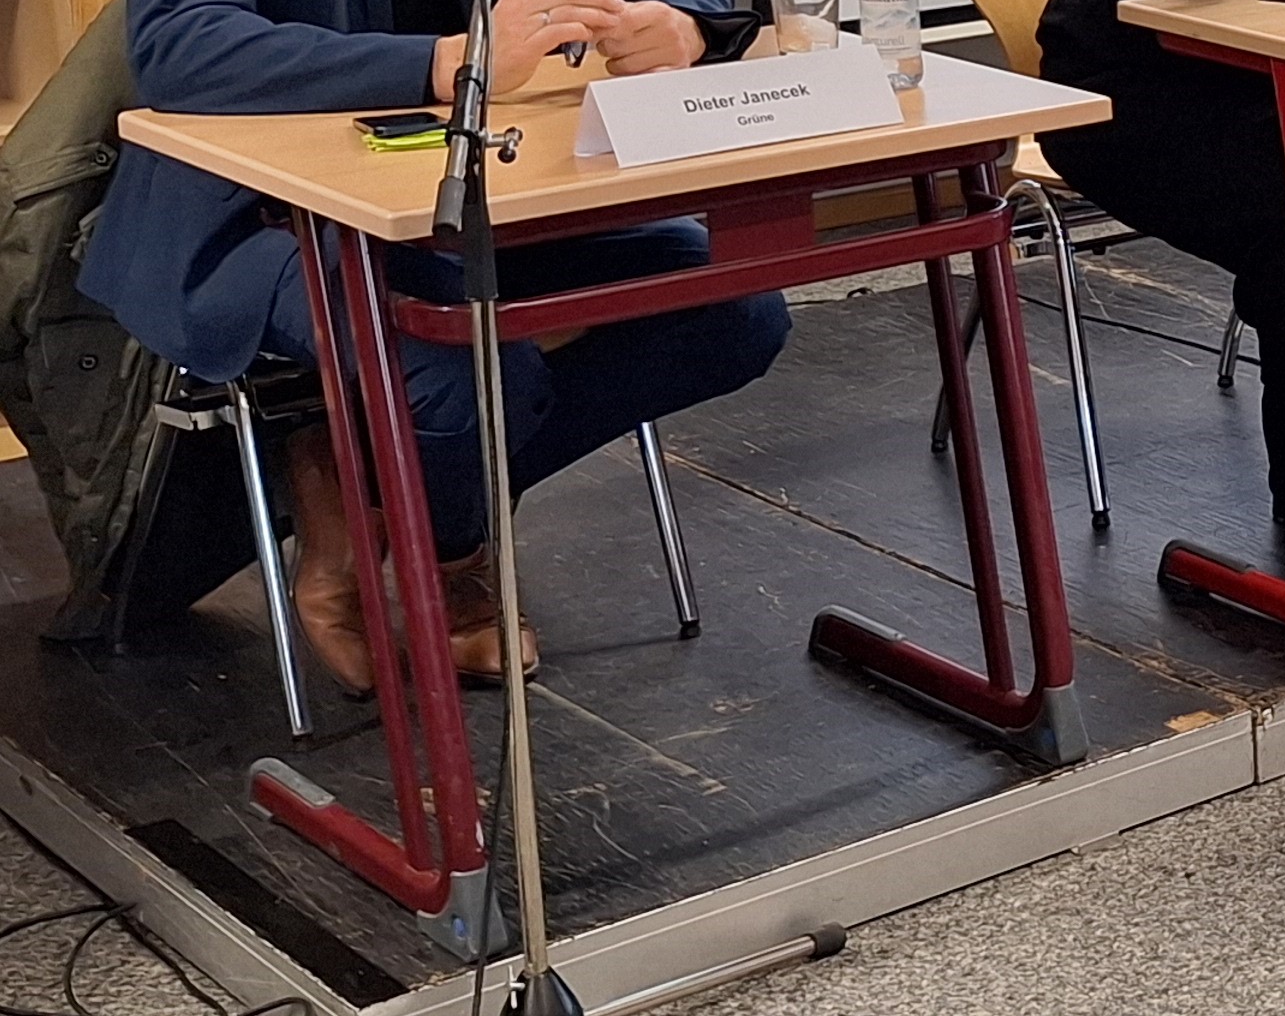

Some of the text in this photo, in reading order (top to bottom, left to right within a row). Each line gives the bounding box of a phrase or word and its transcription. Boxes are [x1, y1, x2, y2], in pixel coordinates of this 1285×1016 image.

[683, 83, 811, 114] Dieter Janecek
[737, 111, 776, 127] Grüne
